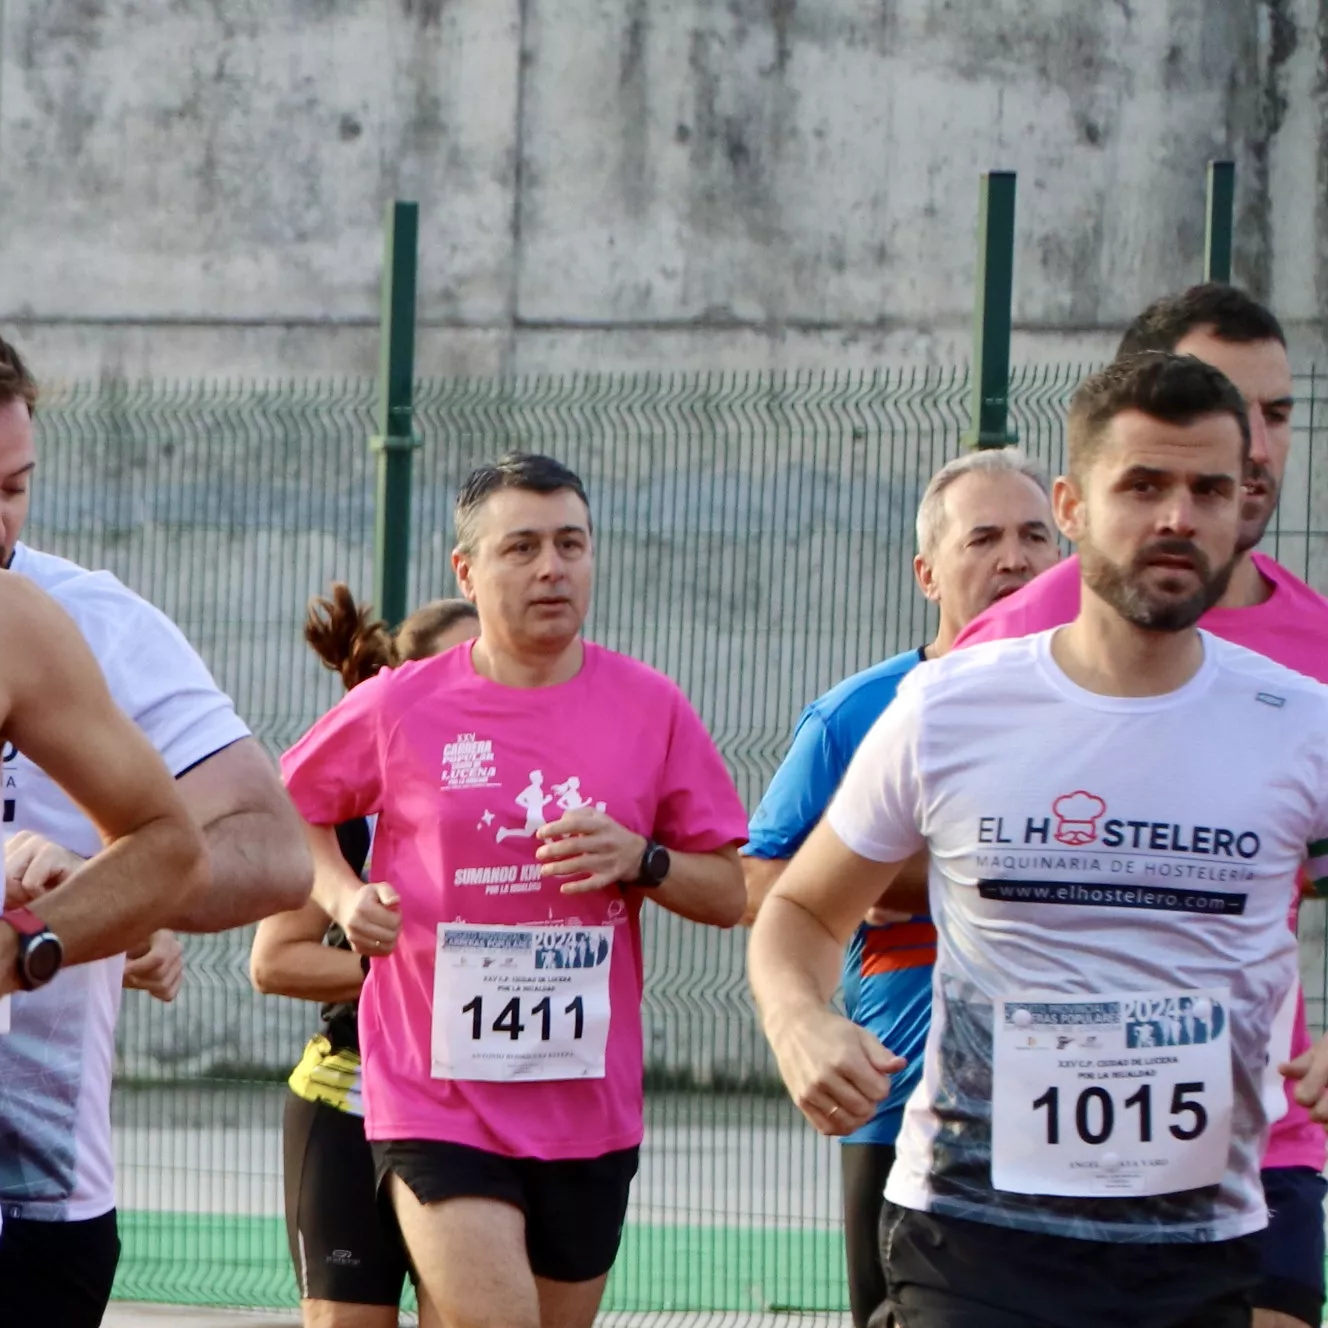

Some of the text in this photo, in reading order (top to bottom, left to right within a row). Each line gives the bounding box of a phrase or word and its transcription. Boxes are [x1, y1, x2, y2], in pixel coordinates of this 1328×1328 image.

[441, 766, 496, 780] LUCENA
[978, 817, 1011, 843] EL
[454, 866, 517, 886] SUMANDO
[976, 855, 1101, 871] MAQUINARIA
[1110, 860, 1135, 874] DE
[999, 883, 1225, 909] www.elhostelero.com
[534, 931, 577, 947] 2024
[462, 995, 584, 1041] 1411
[1124, 999, 1178, 1022] 2024
[1033, 1081, 1208, 1145] 1015
